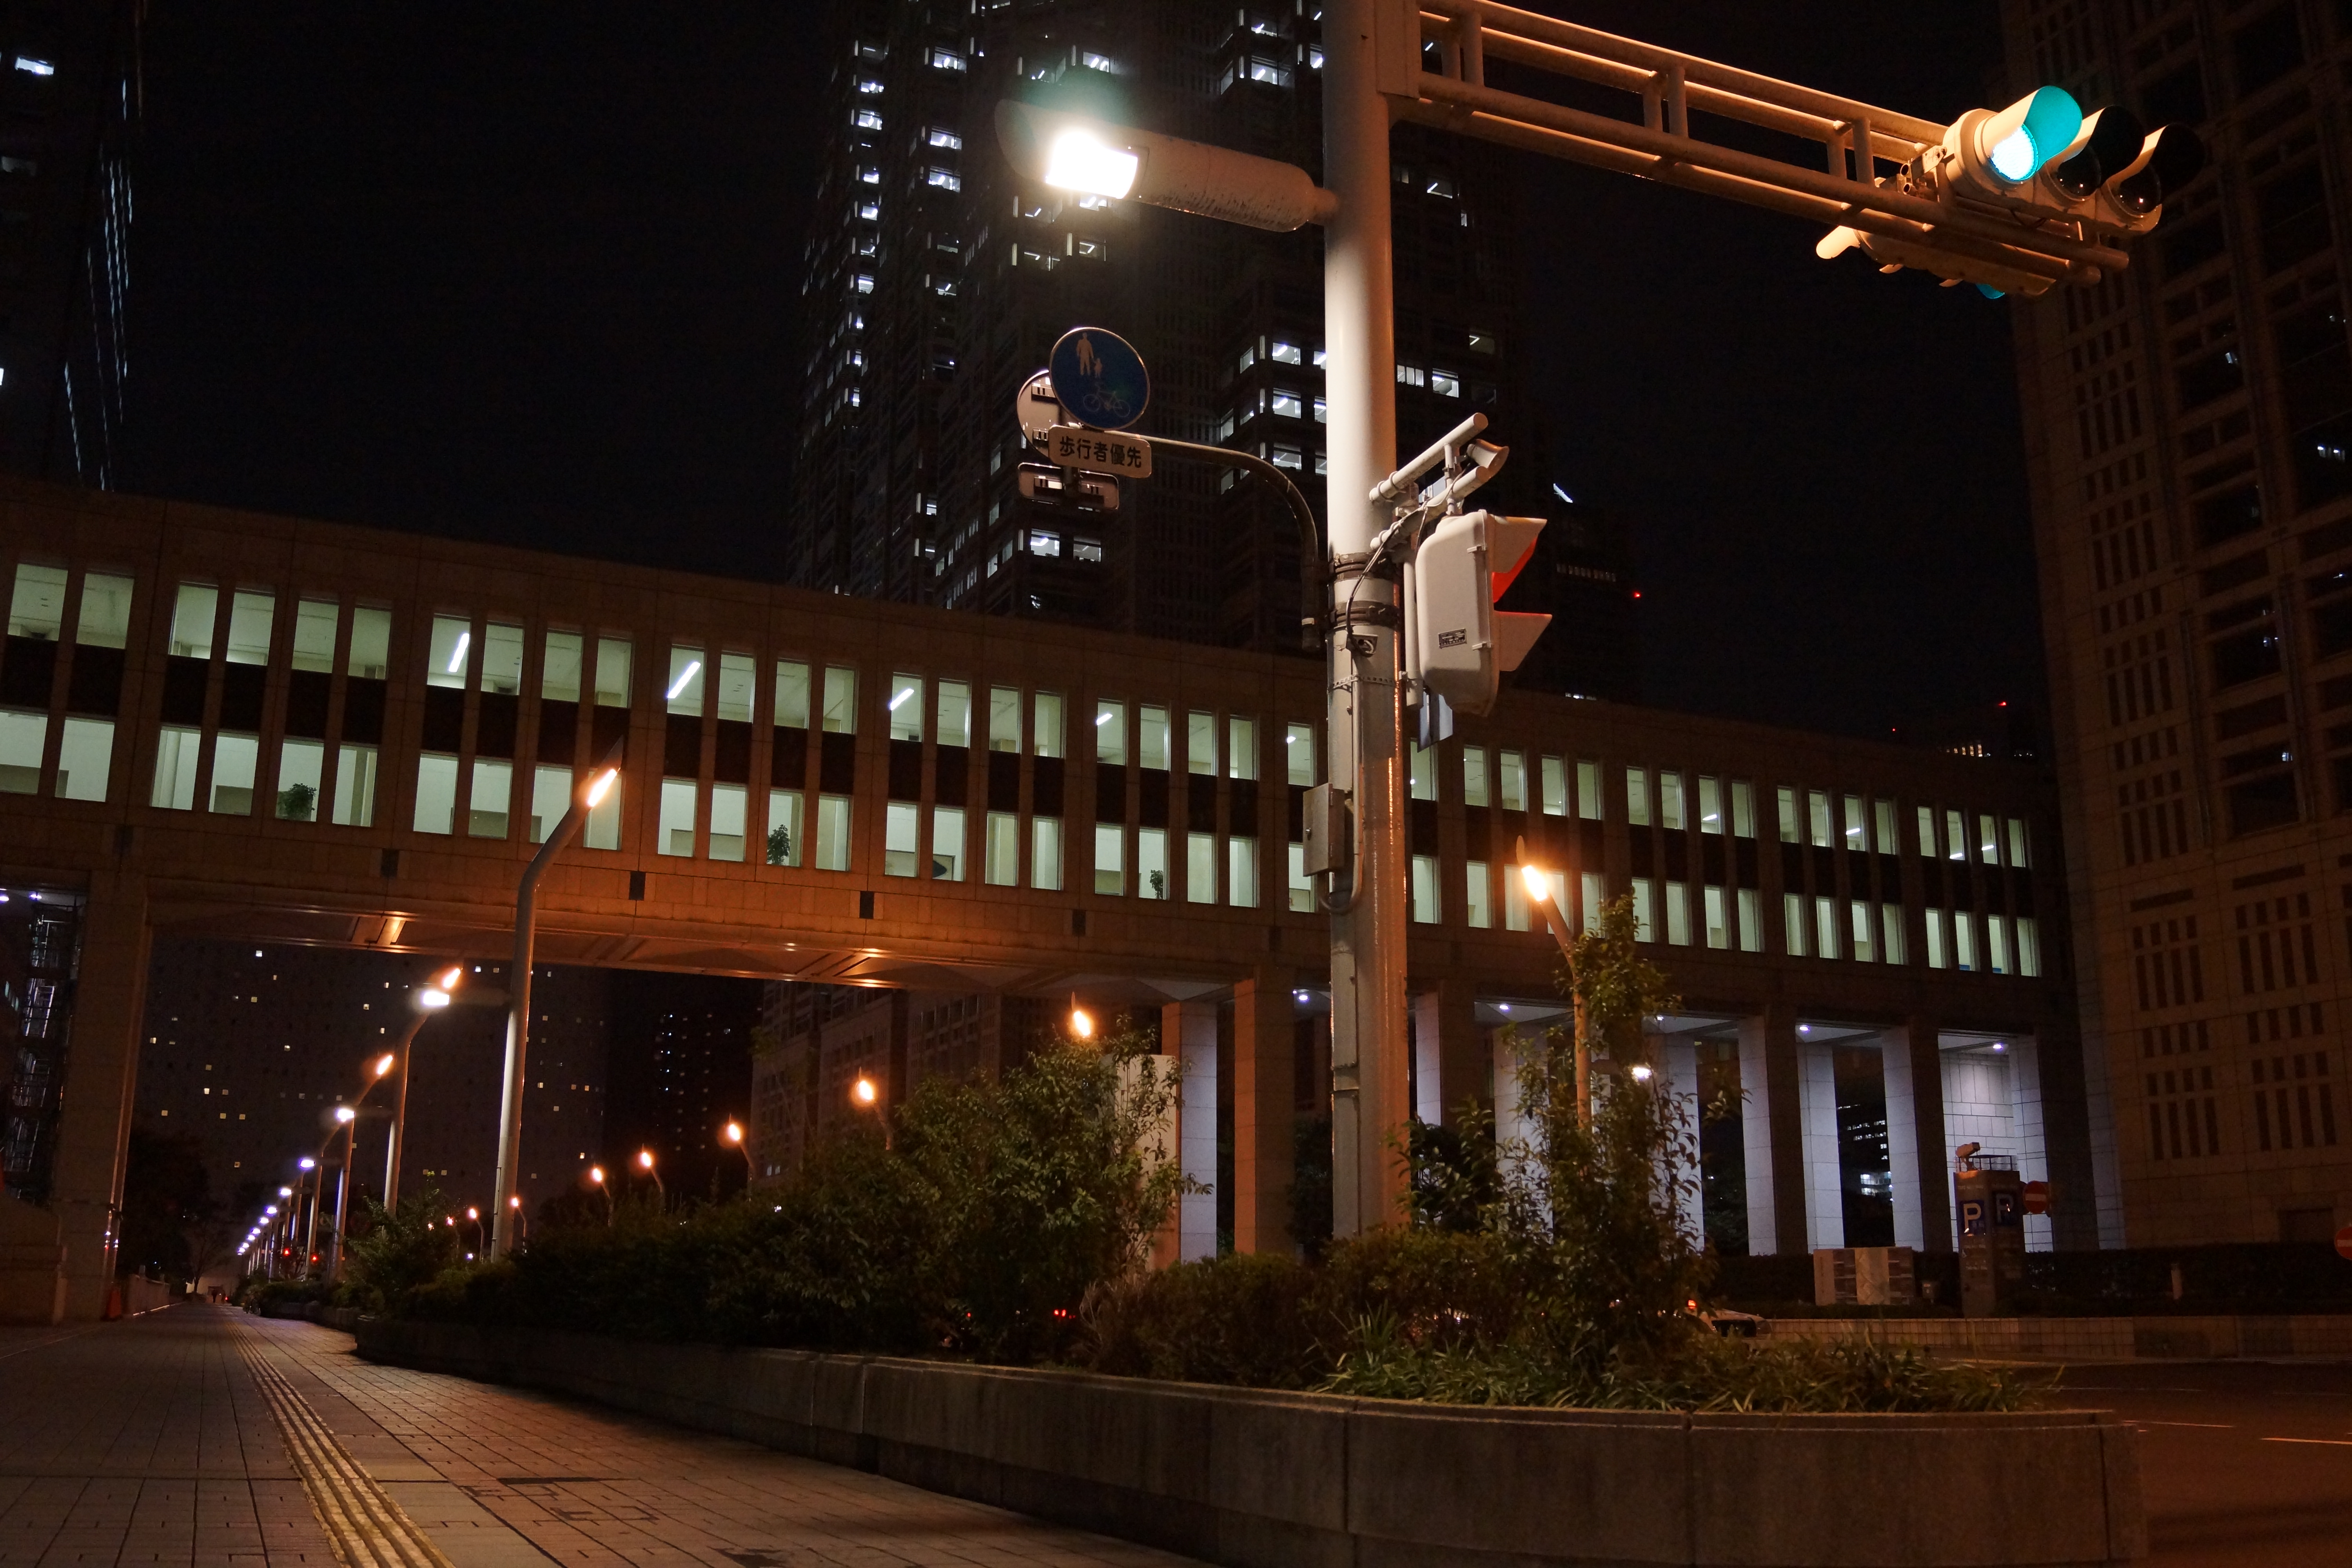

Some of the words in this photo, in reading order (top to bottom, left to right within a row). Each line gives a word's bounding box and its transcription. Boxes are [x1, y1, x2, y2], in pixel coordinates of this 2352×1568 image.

[1060, 436, 1142, 468] 歩行者優先
[1963, 1203, 1982, 1233] P
[1995, 1193, 2014, 1223] P
